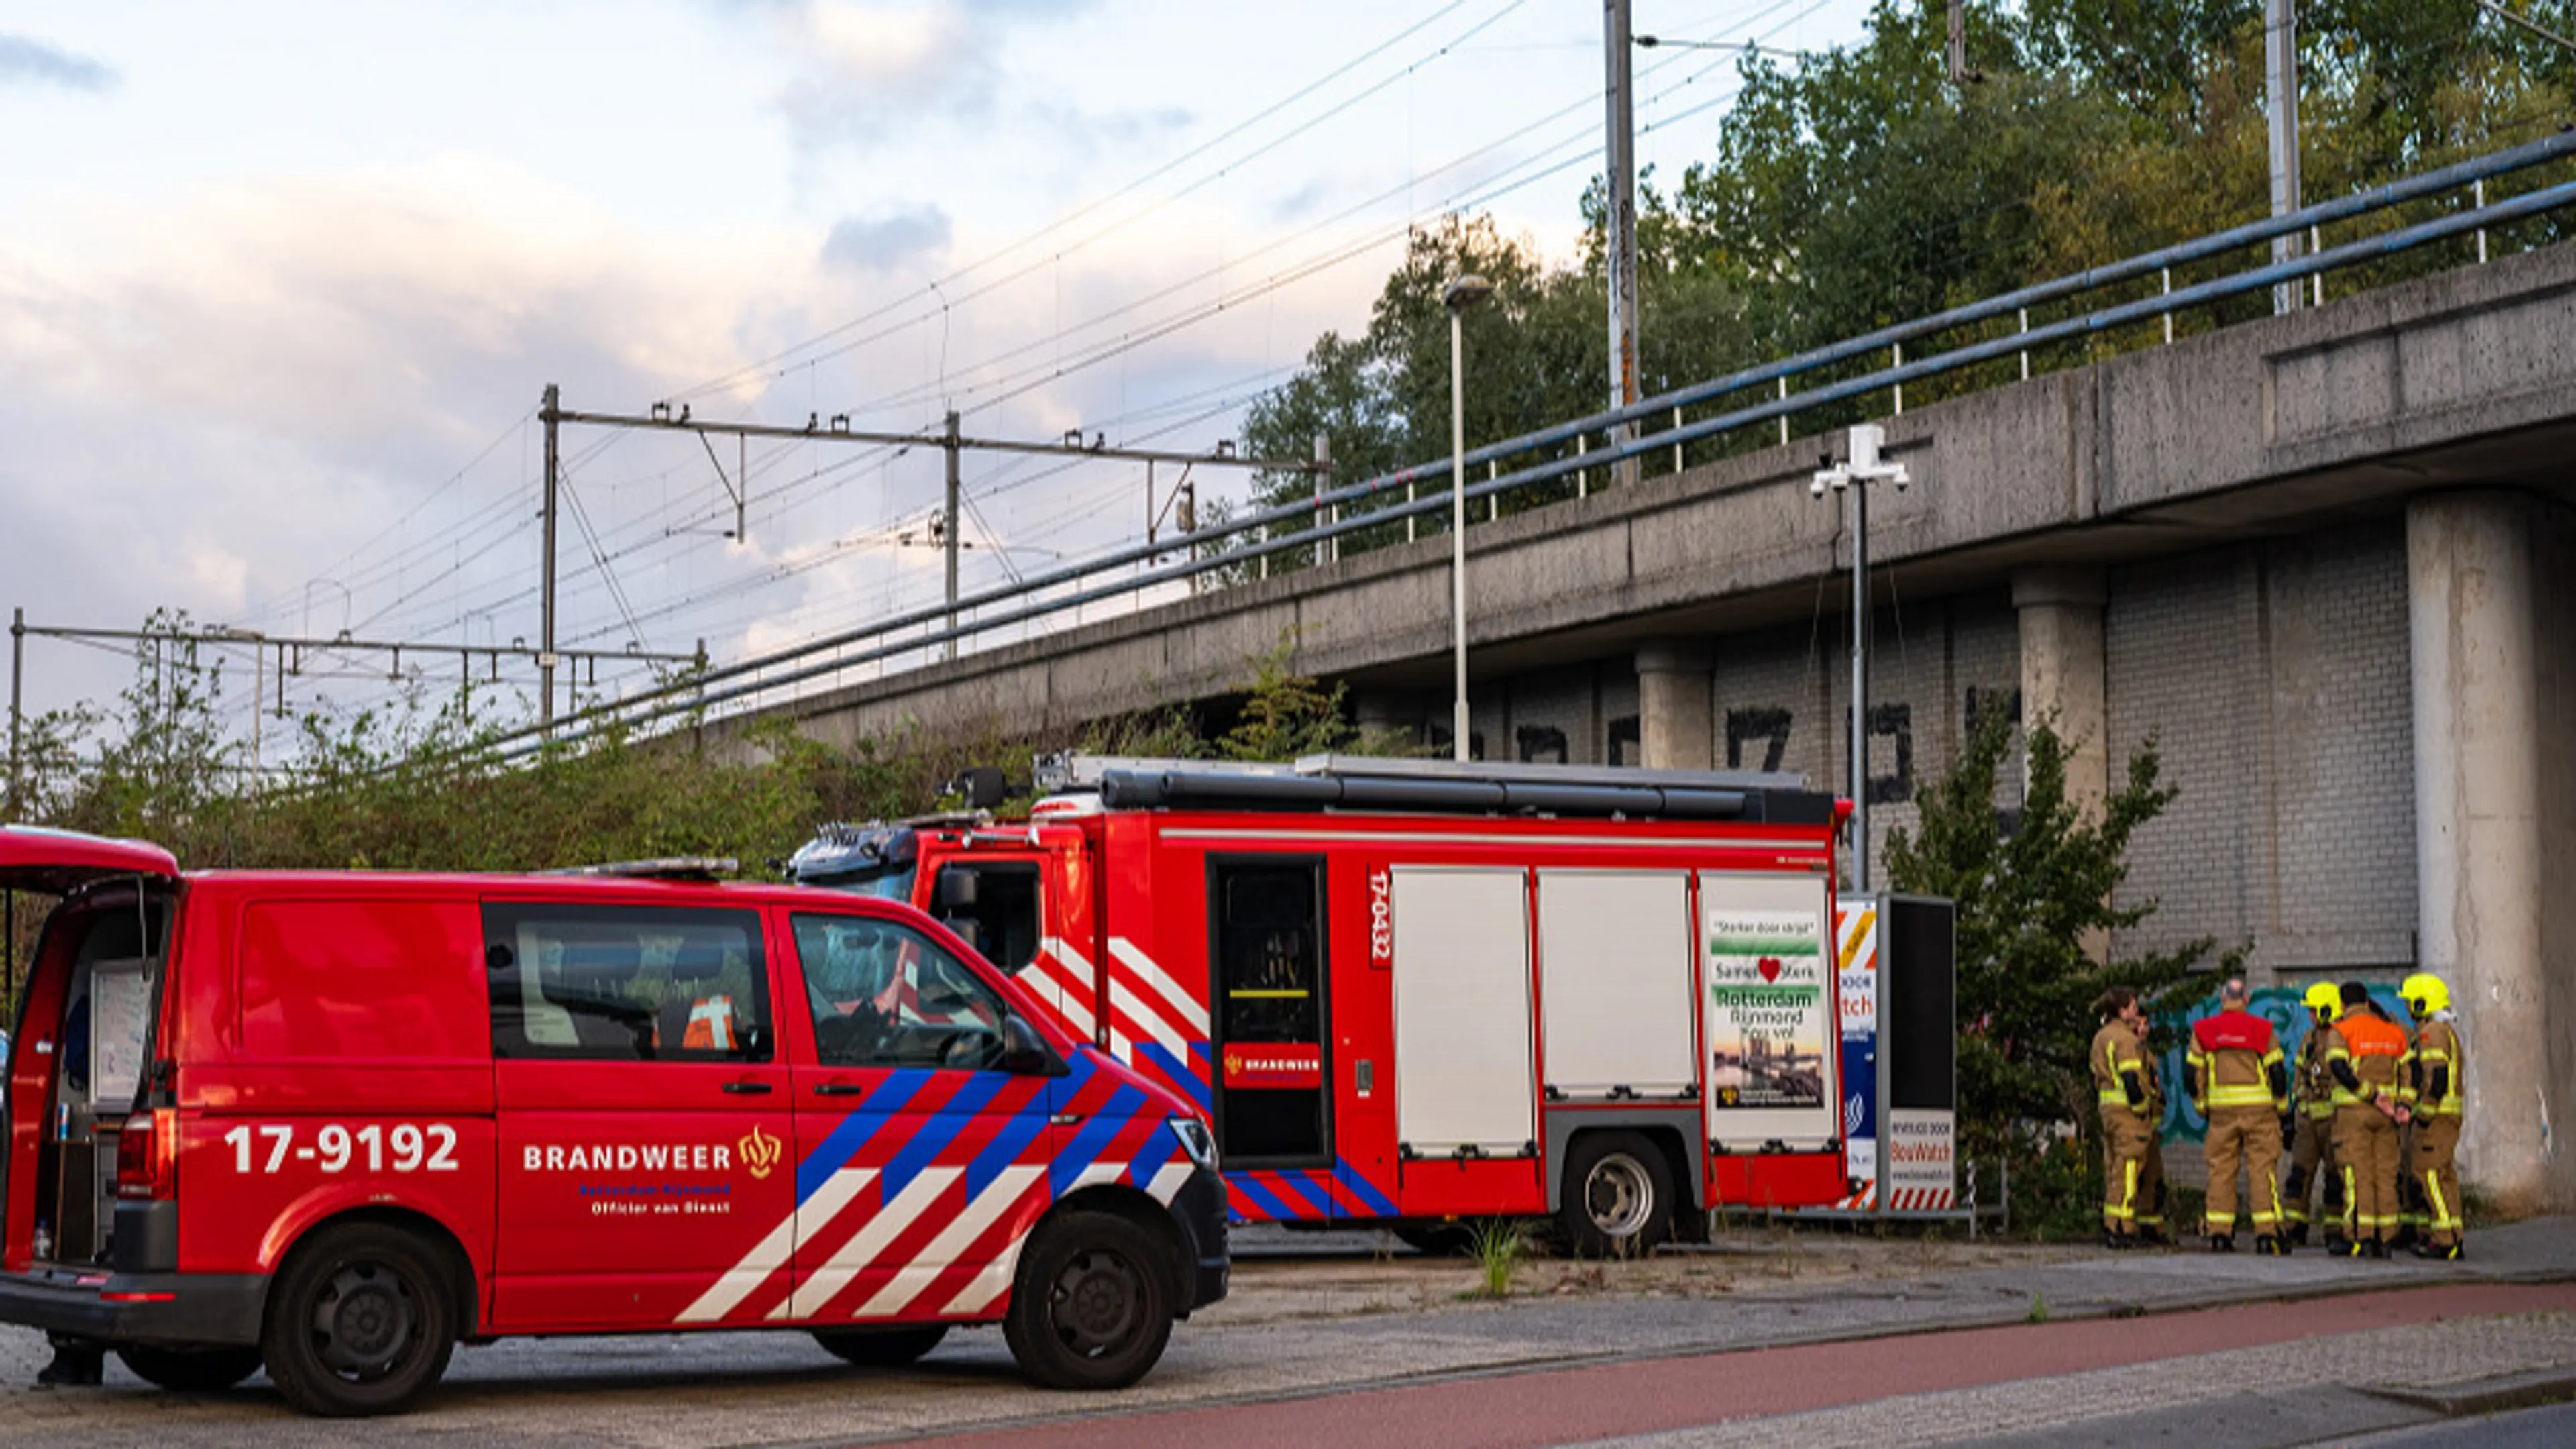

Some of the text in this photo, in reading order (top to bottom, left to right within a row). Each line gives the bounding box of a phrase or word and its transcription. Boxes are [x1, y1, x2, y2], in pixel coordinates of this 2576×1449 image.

[1371, 871, 1390, 959] 17-0432
[1716, 988, 1812, 1007] Rotterdam
[1730, 1008, 1803, 1026] Rijnmond
[225, 1124, 459, 1173] 17-9192
[523, 1145, 731, 1171] BRANDWEER
[590, 1201, 648, 1216] Officier
[653, 1203, 680, 1214] van
